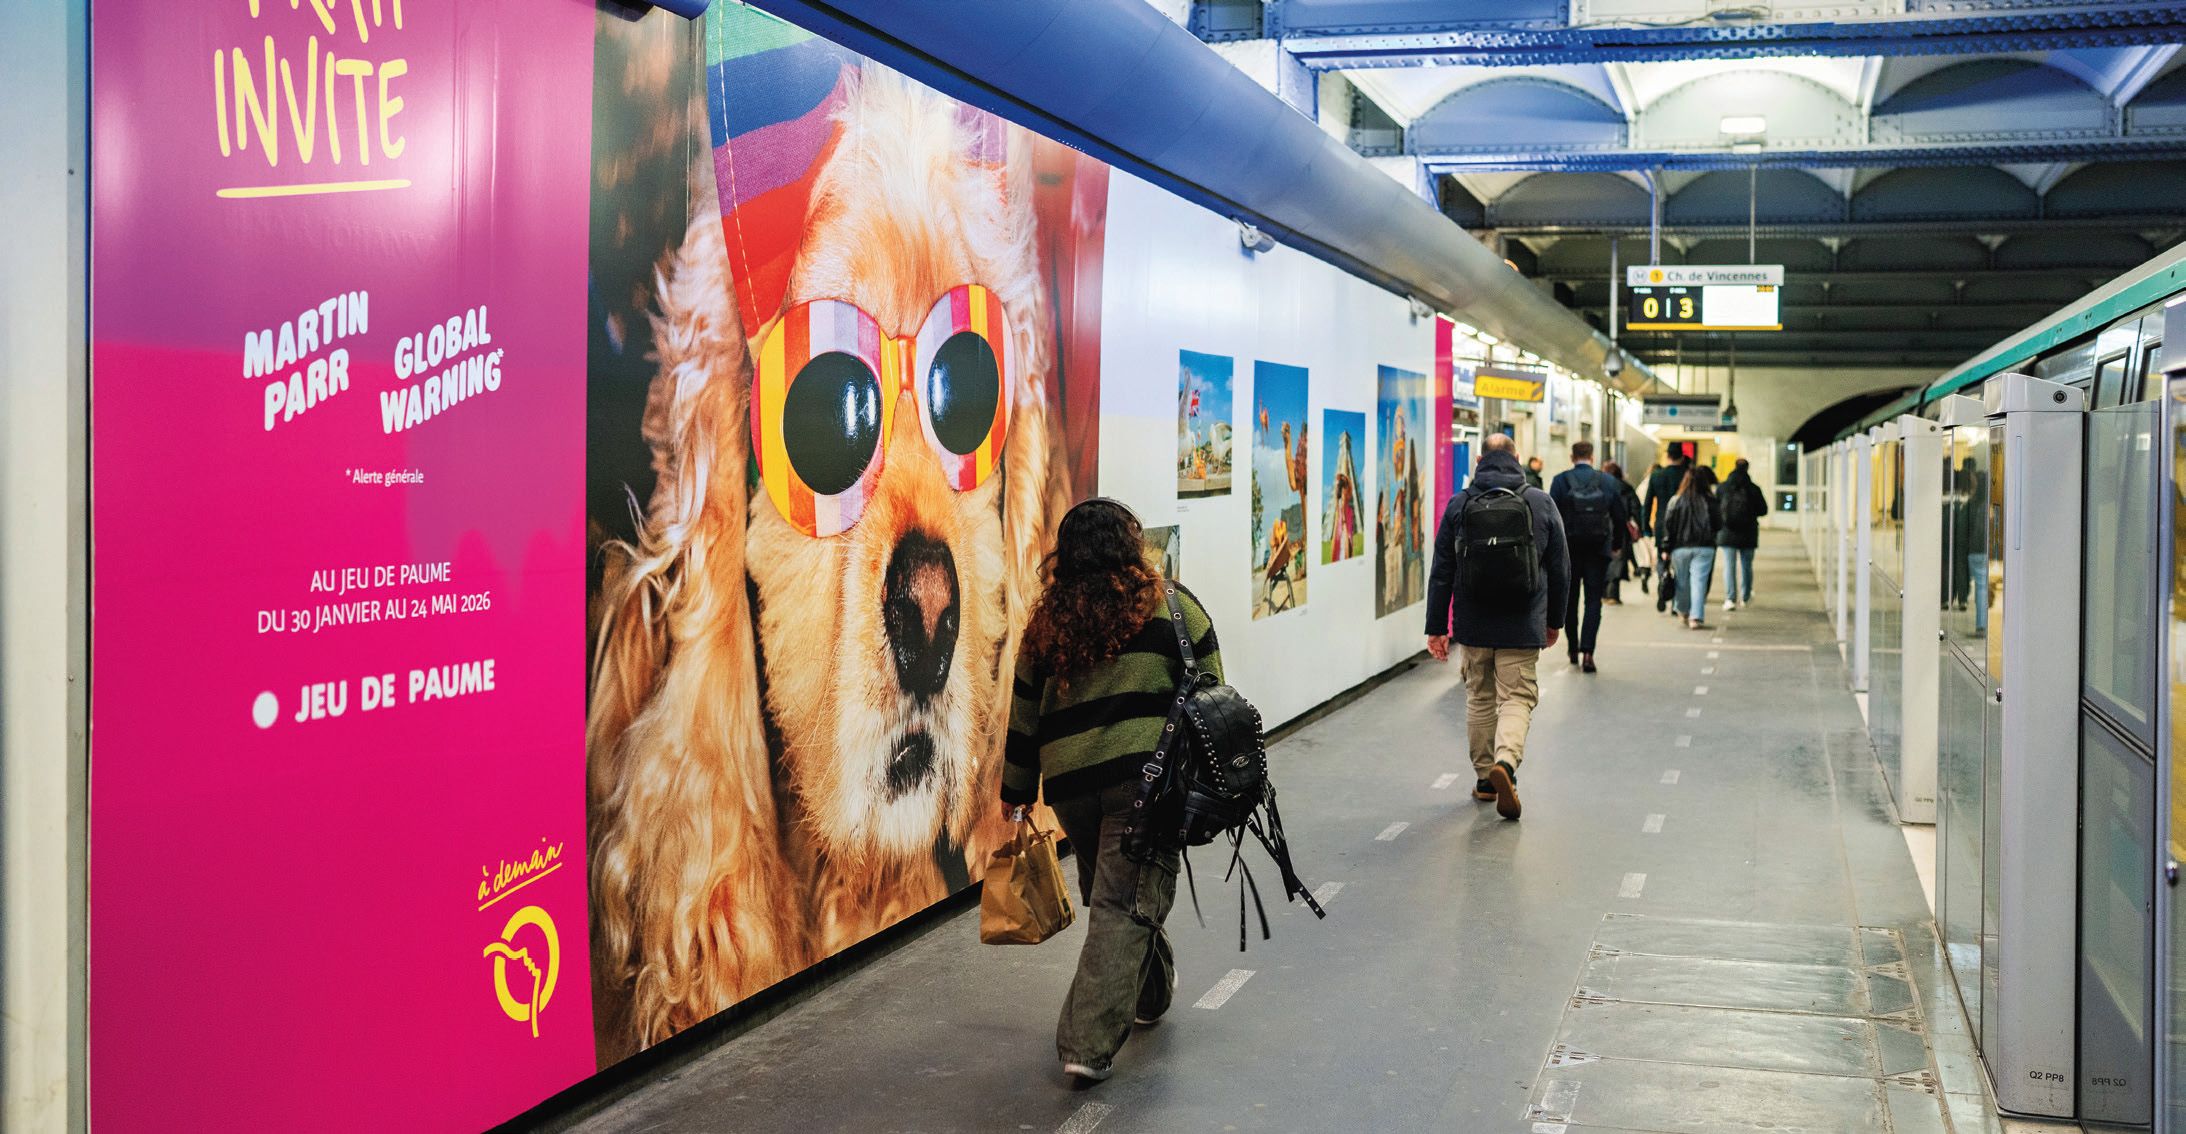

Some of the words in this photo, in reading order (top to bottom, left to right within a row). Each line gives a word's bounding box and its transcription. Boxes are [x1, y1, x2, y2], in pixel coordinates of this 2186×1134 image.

[214, 35, 408, 167] INVITE
[1668, 271, 1685, 281] Ch.
[1689, 271, 1703, 281] de
[1707, 271, 1768, 281] Vincennes
[1643, 297, 1659, 319] 0
[1679, 297, 1694, 319] 3
[243, 290, 369, 379] MARTIN
[394, 304, 492, 380] GLOBAL
[264, 348, 349, 431] PARR
[1481, 382, 1527, 397] Alarme
[384, 468, 425, 488] générale
[310, 570, 336, 593] AU
[339, 567, 369, 597] JEU
[374, 565, 396, 588] DE
[400, 562, 451, 586] PAUME
[257, 609, 286, 634] DU
[290, 609, 311, 633] 30
[313, 601, 381, 634] JANVIER
[384, 598, 408, 620] AU
[410, 599, 428, 619] 24
[431, 593, 457, 615] MAI
[460, 591, 491, 614] 2026
[295, 680, 347, 724] JEU
[361, 673, 396, 711] DE
[409, 659, 495, 704] PAUME
[477, 865, 490, 901] à
[493, 837, 564, 892] demain
[2029, 1070, 2043, 1080] Q2
[2045, 1072, 2065, 1083] PP8
